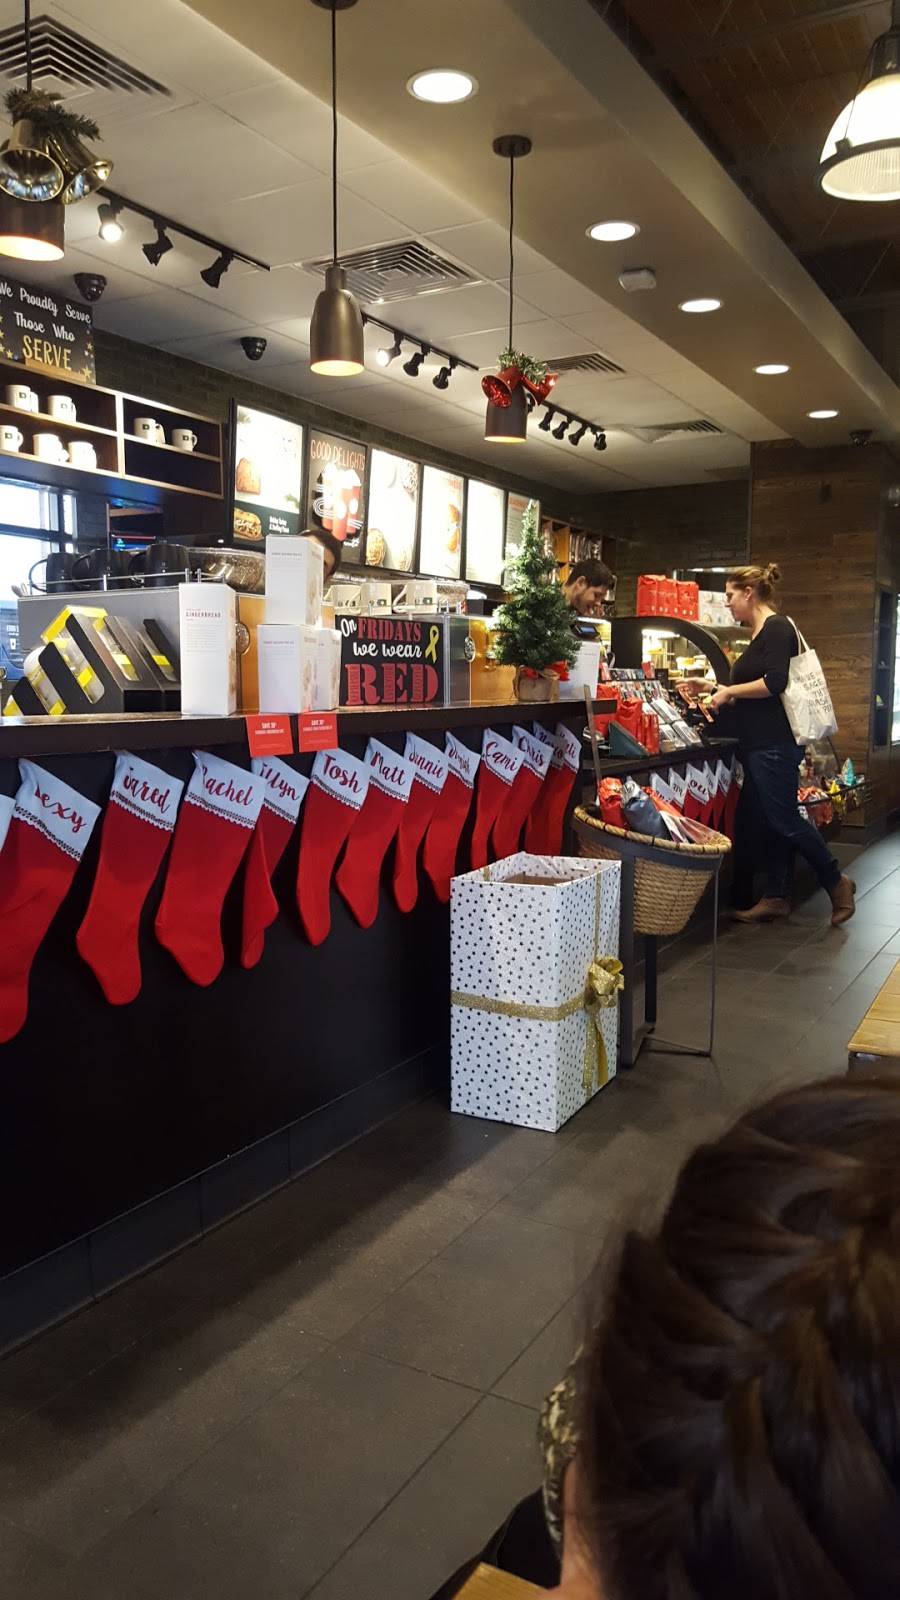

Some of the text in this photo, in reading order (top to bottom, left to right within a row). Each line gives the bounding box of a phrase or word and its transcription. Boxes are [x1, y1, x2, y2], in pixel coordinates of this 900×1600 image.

[20, 287, 58, 317] Proudly
[65, 304, 91, 324] Serve
[14, 311, 75, 342] Those Who
[23, 335, 72, 371] SERVE
[311, 439, 365, 471] GOOD DELIGHTS
[340, 617, 421, 642] On FRIDAYS
[353, 642, 422, 658] we wear
[345, 663, 439, 705] RED
[370, 751, 406, 786] Matt
